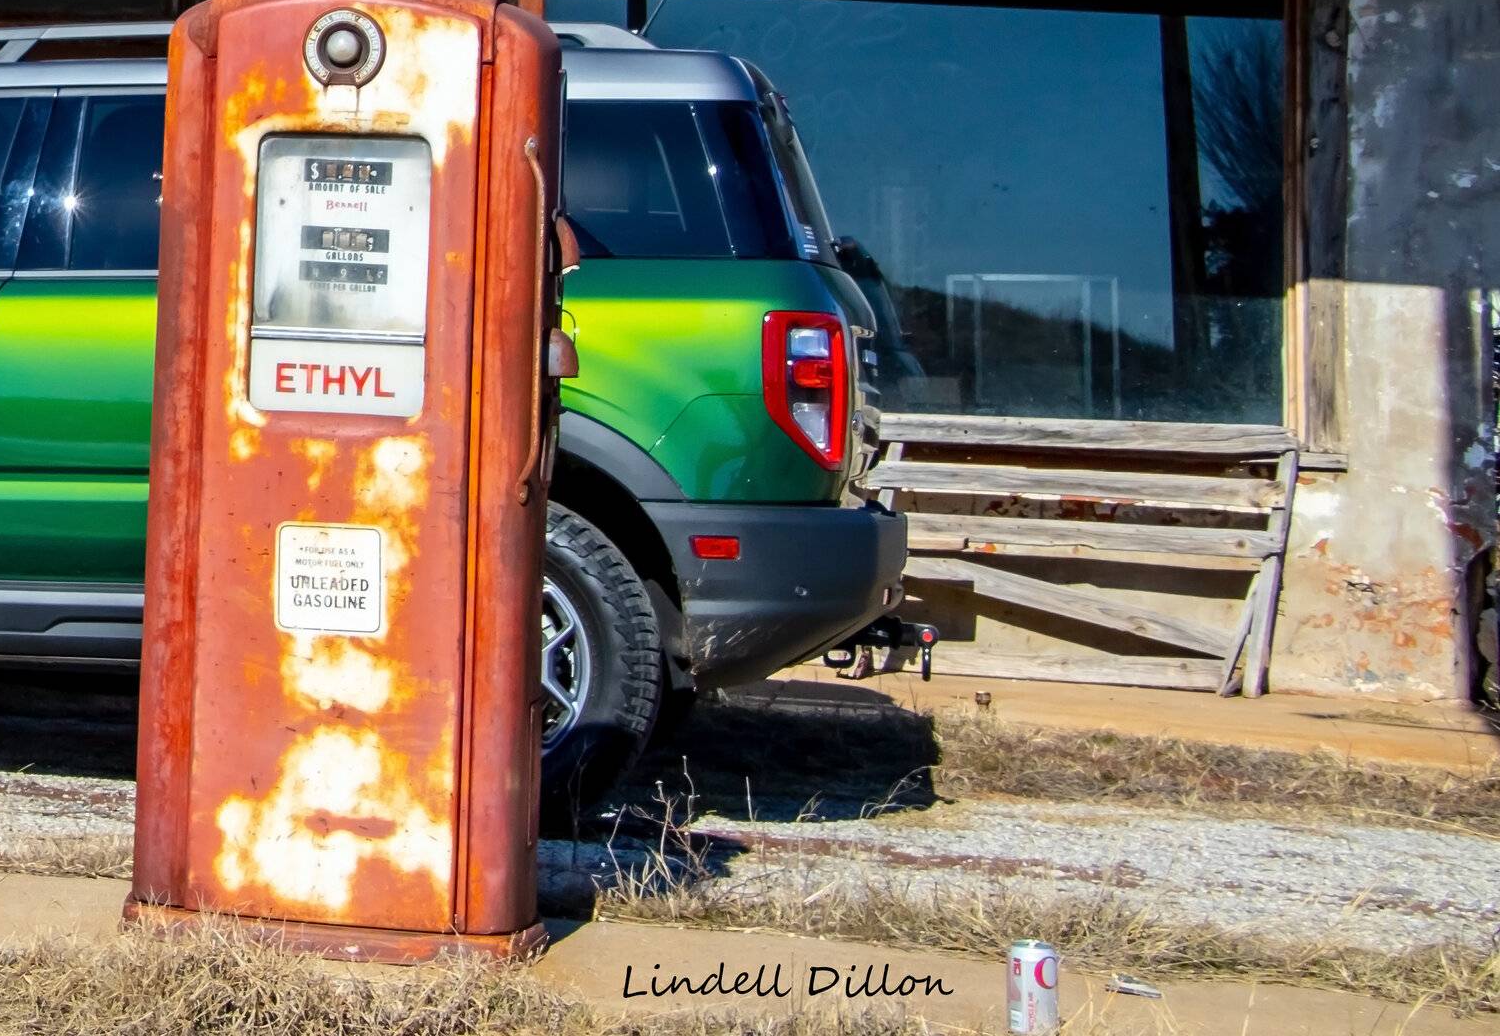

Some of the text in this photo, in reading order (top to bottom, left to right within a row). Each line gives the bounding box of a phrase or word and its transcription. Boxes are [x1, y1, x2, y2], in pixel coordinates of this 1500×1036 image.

[350, 184, 359, 193] OF
[365, 185, 385, 194] SALE
[325, 251, 364, 261] GALLONS
[275, 362, 395, 398] ETHYL
[295, 558, 322, 566] MOTOR
[324, 559, 343, 567] FUEL
[290, 575, 369, 592] UNLEADED
[293, 594, 366, 610] GASOLINE
